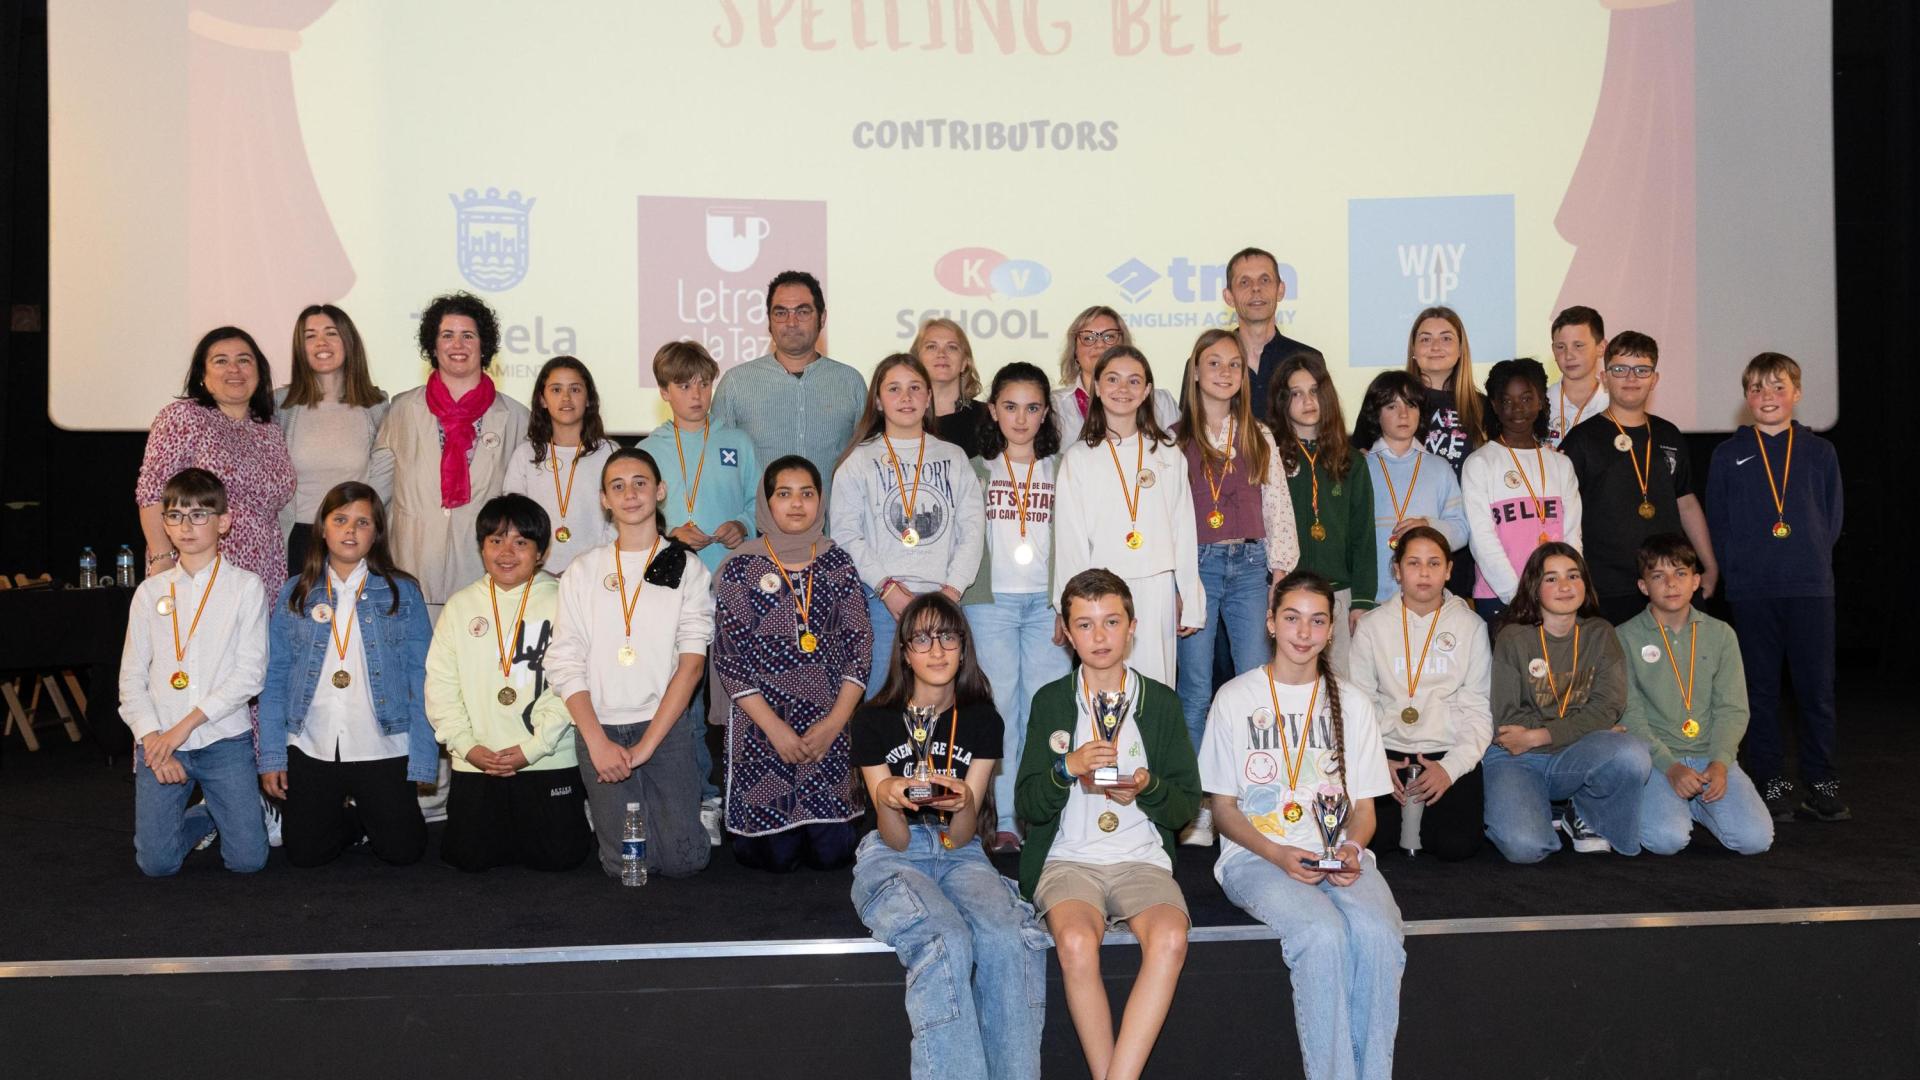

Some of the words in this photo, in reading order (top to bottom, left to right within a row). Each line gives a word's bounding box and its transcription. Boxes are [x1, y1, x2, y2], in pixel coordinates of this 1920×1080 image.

[1111, 0, 1243, 56] BEE
[852, 119, 1119, 152] CONTRIBUTORS
[962, 258, 986, 288] K
[1010, 268, 1031, 290] V
[1397, 243, 1466, 277] WAY
[677, 279, 768, 324] Letra
[1418, 272, 1459, 305] UP
[728, 328, 772, 362] Taz
[1026, 512, 1048, 523] STOP
